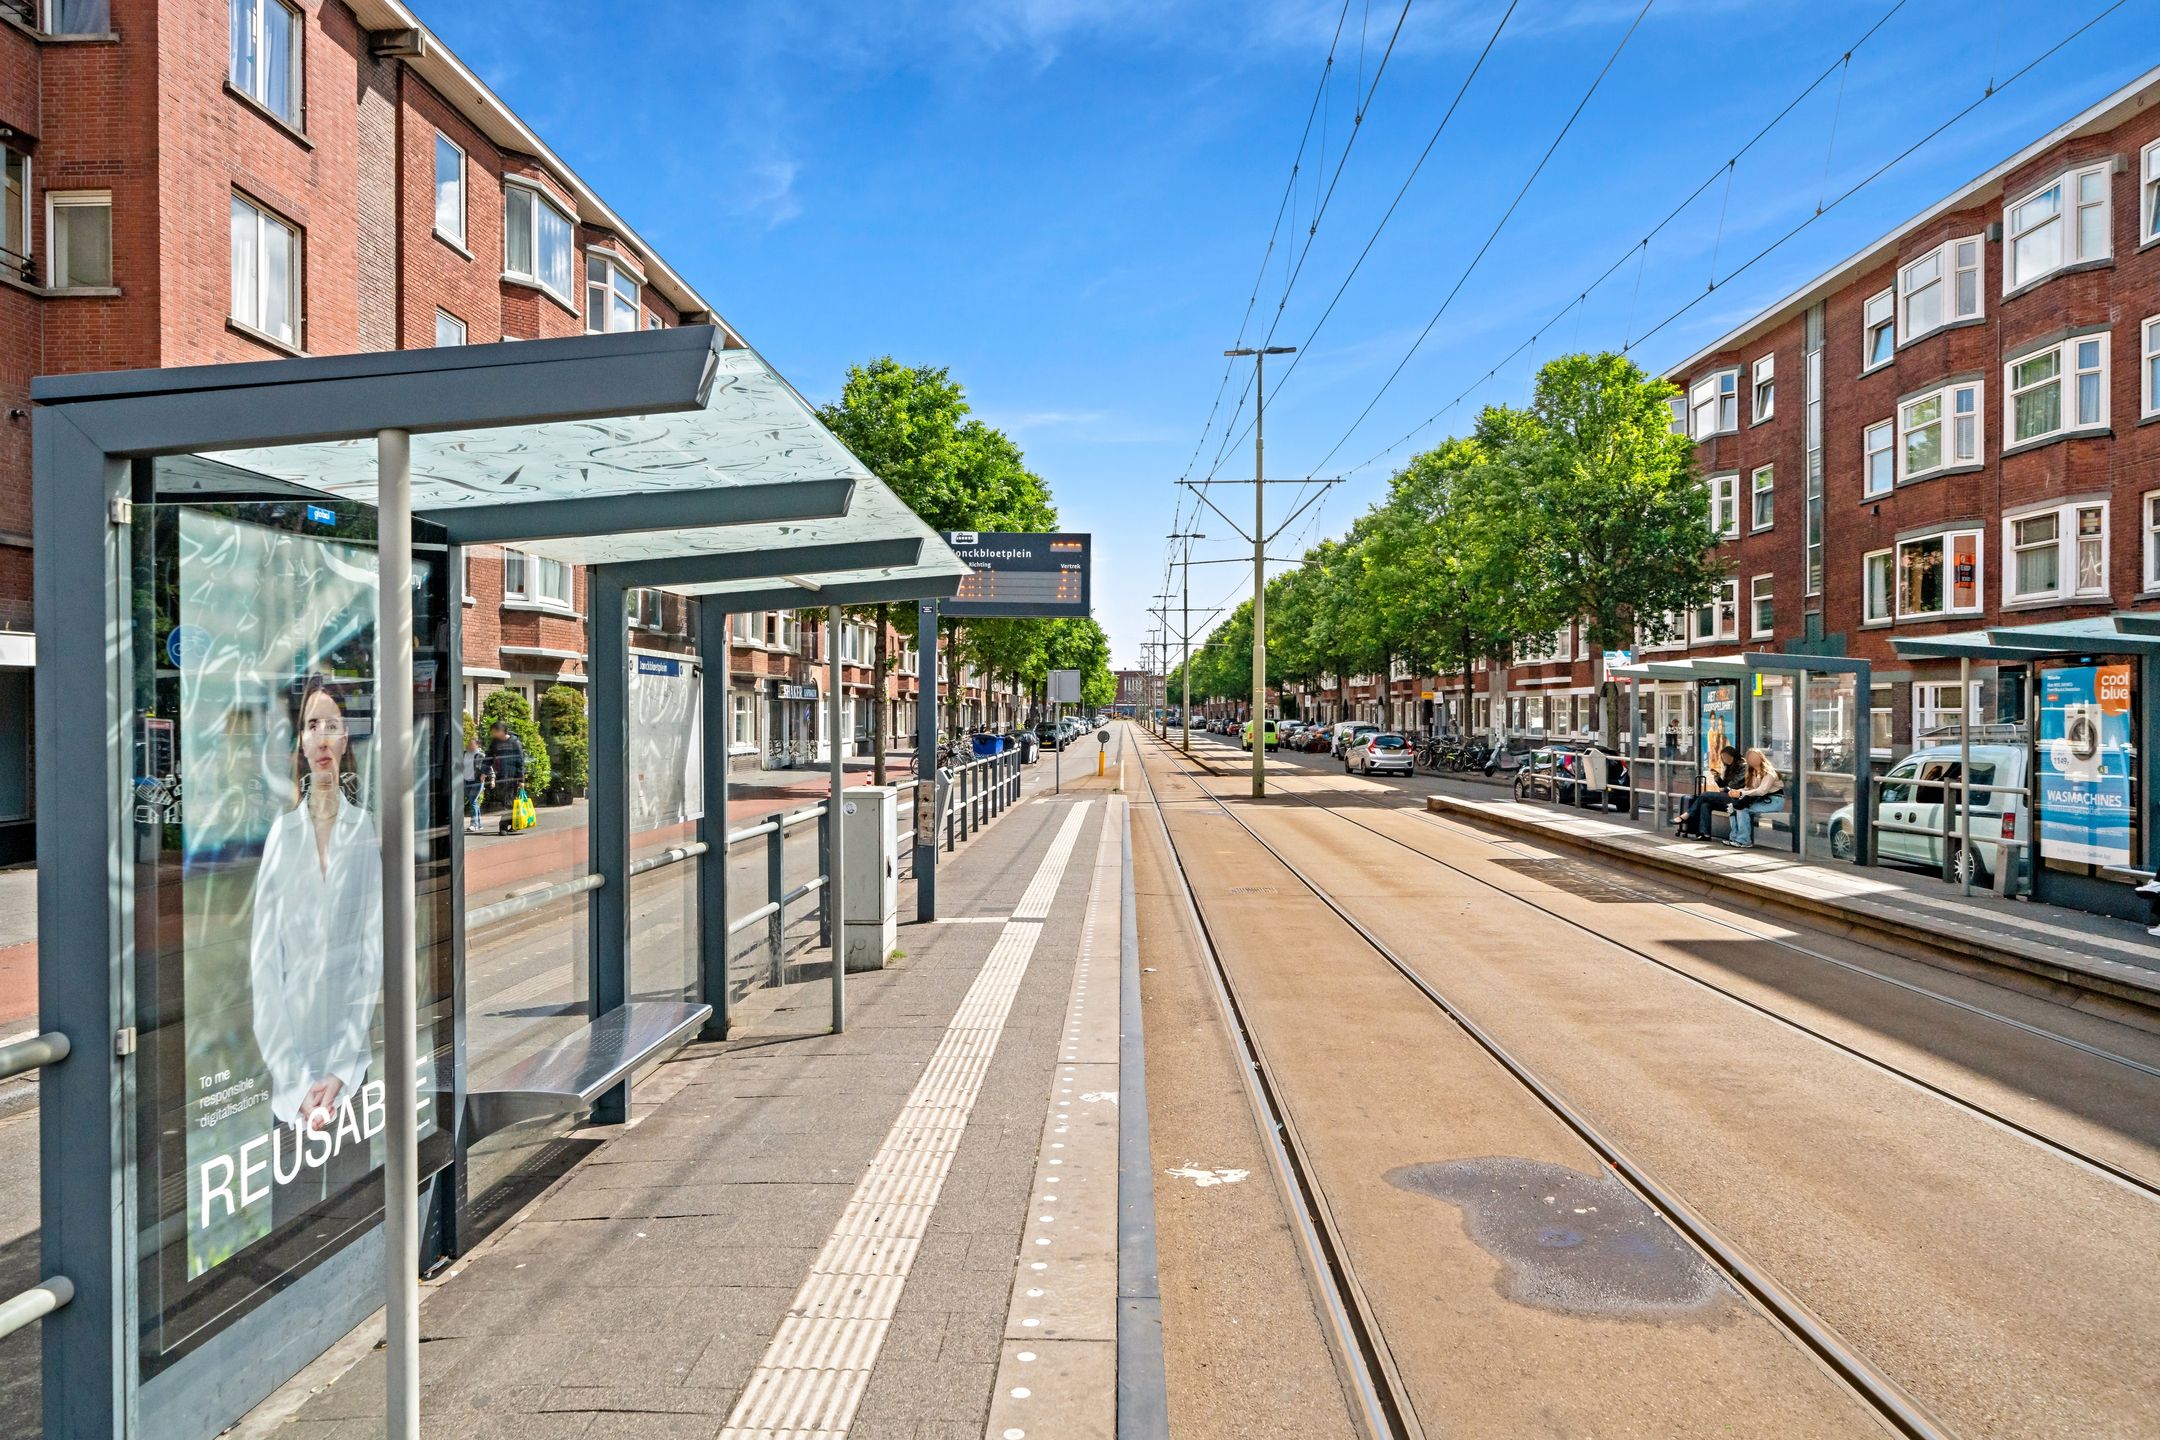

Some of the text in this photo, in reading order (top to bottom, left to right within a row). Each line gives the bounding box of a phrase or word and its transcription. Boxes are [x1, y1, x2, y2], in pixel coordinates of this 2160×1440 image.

[968, 561, 992, 569] Richting
[2101, 672, 2129, 685] cool
[2101, 686, 2129, 700] blue
[2047, 790, 2122, 807] WASMACHINES
[199, 1069, 231, 1090] To me
[200, 1078, 255, 1109] responsible
[200, 1096, 260, 1128] digitalisation
[200, 1056, 431, 1230] REUSABE
